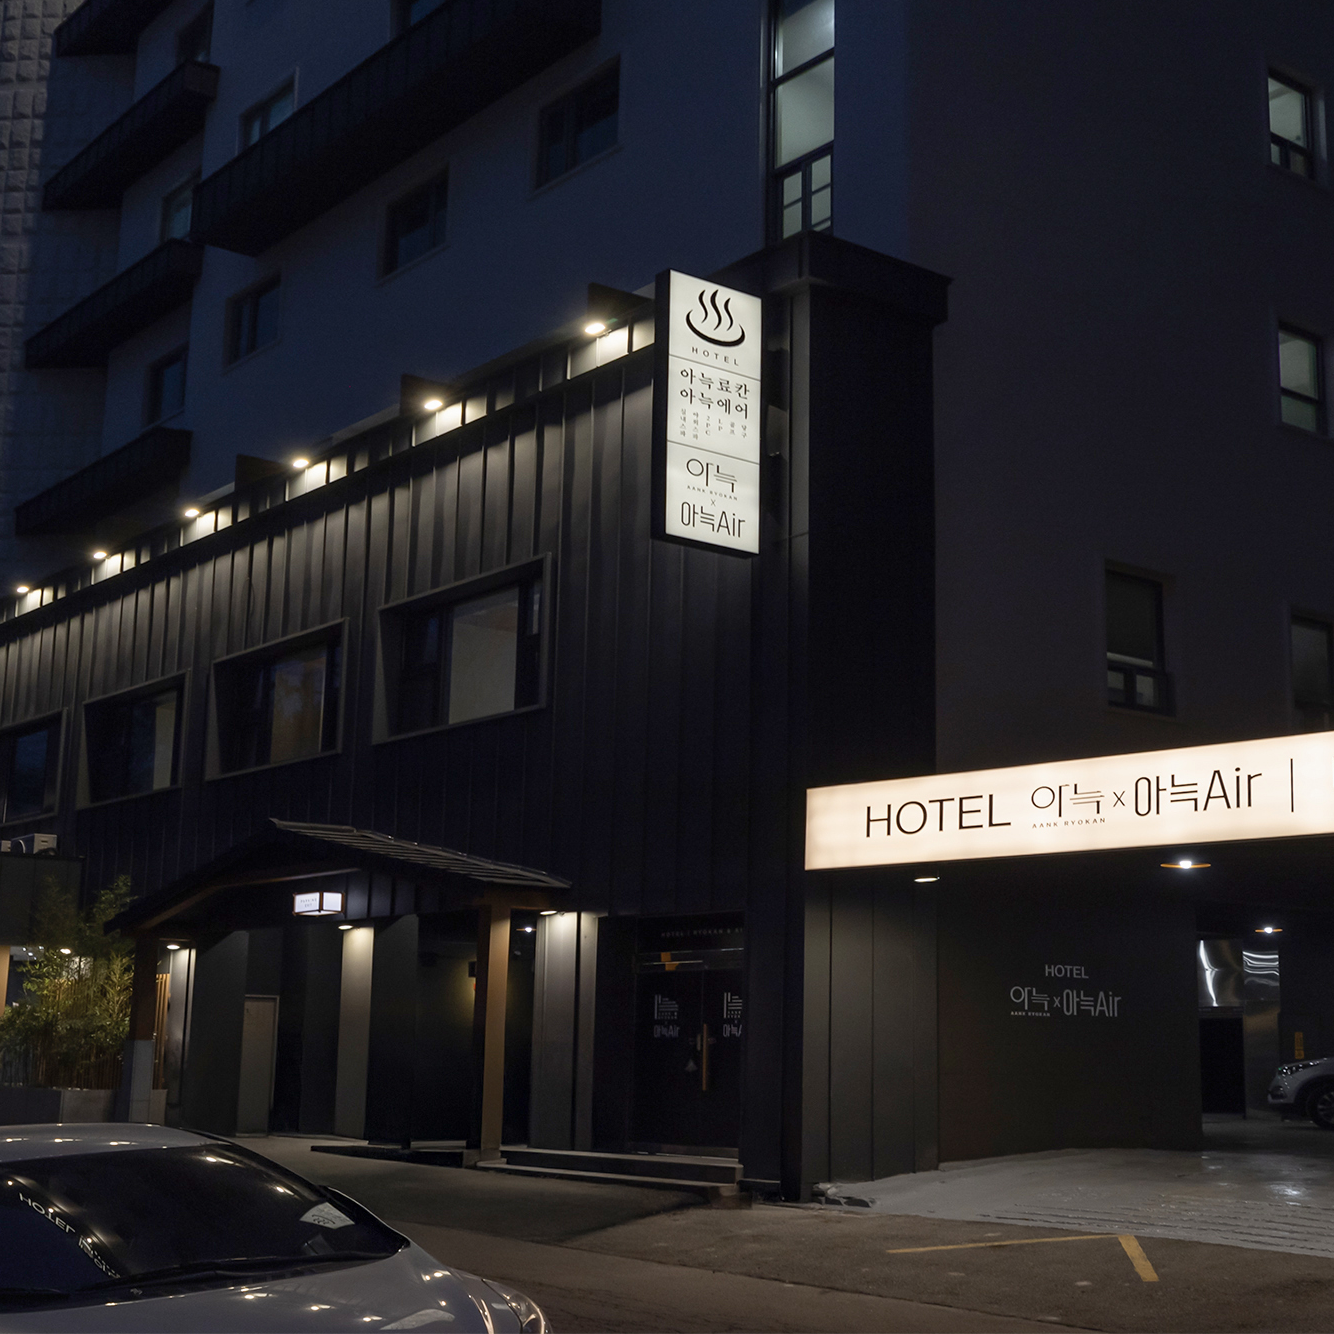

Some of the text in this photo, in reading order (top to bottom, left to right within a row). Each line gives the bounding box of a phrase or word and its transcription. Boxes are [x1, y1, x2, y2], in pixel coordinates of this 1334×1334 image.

[691, 346, 739, 367] HOTEL
[680, 367, 750, 400] 아늑료칸
[679, 387, 748, 420] 아늑에어
[686, 458, 738, 494] 아늑
[681, 501, 746, 538] 아늑Air
[866, 794, 1011, 838] HOTEL
[1031, 783, 1105, 817] 아늑
[1134, 767, 1263, 817] 아늑Air
[1032, 817, 1106, 829] AANK RYOKAN
[1045, 964, 1089, 979] HOTEL
[1010, 986, 1050, 1011] 아늑
[1063, 989, 1122, 1018] 아늑Air
